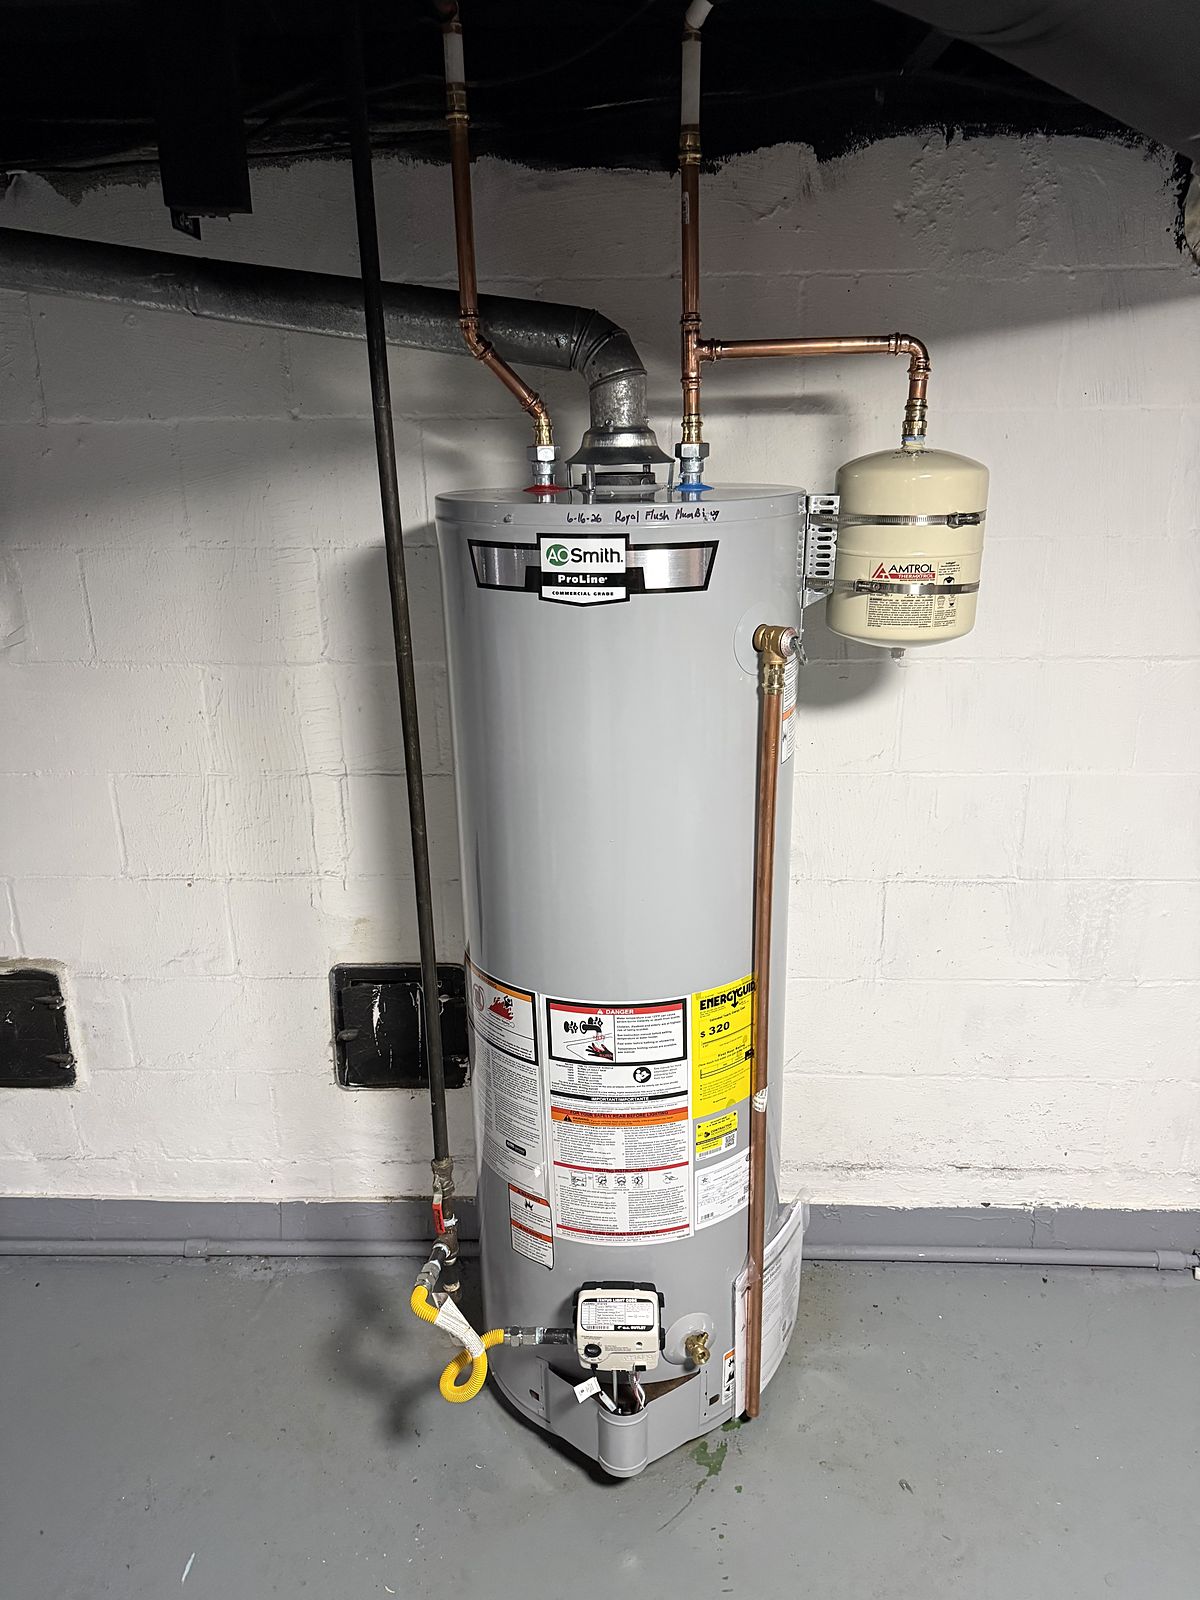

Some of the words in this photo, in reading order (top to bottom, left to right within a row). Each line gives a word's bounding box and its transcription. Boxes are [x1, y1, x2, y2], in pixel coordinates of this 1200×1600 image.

[566, 512, 602, 523] 6-16-26
[615, 510, 640, 525] Royal
[645, 510, 670, 521] Flush
[889, 563, 936, 573] AMTROL
[700, 980, 756, 1010] ENERGYGUID
[709, 1021, 730, 1036] 320
